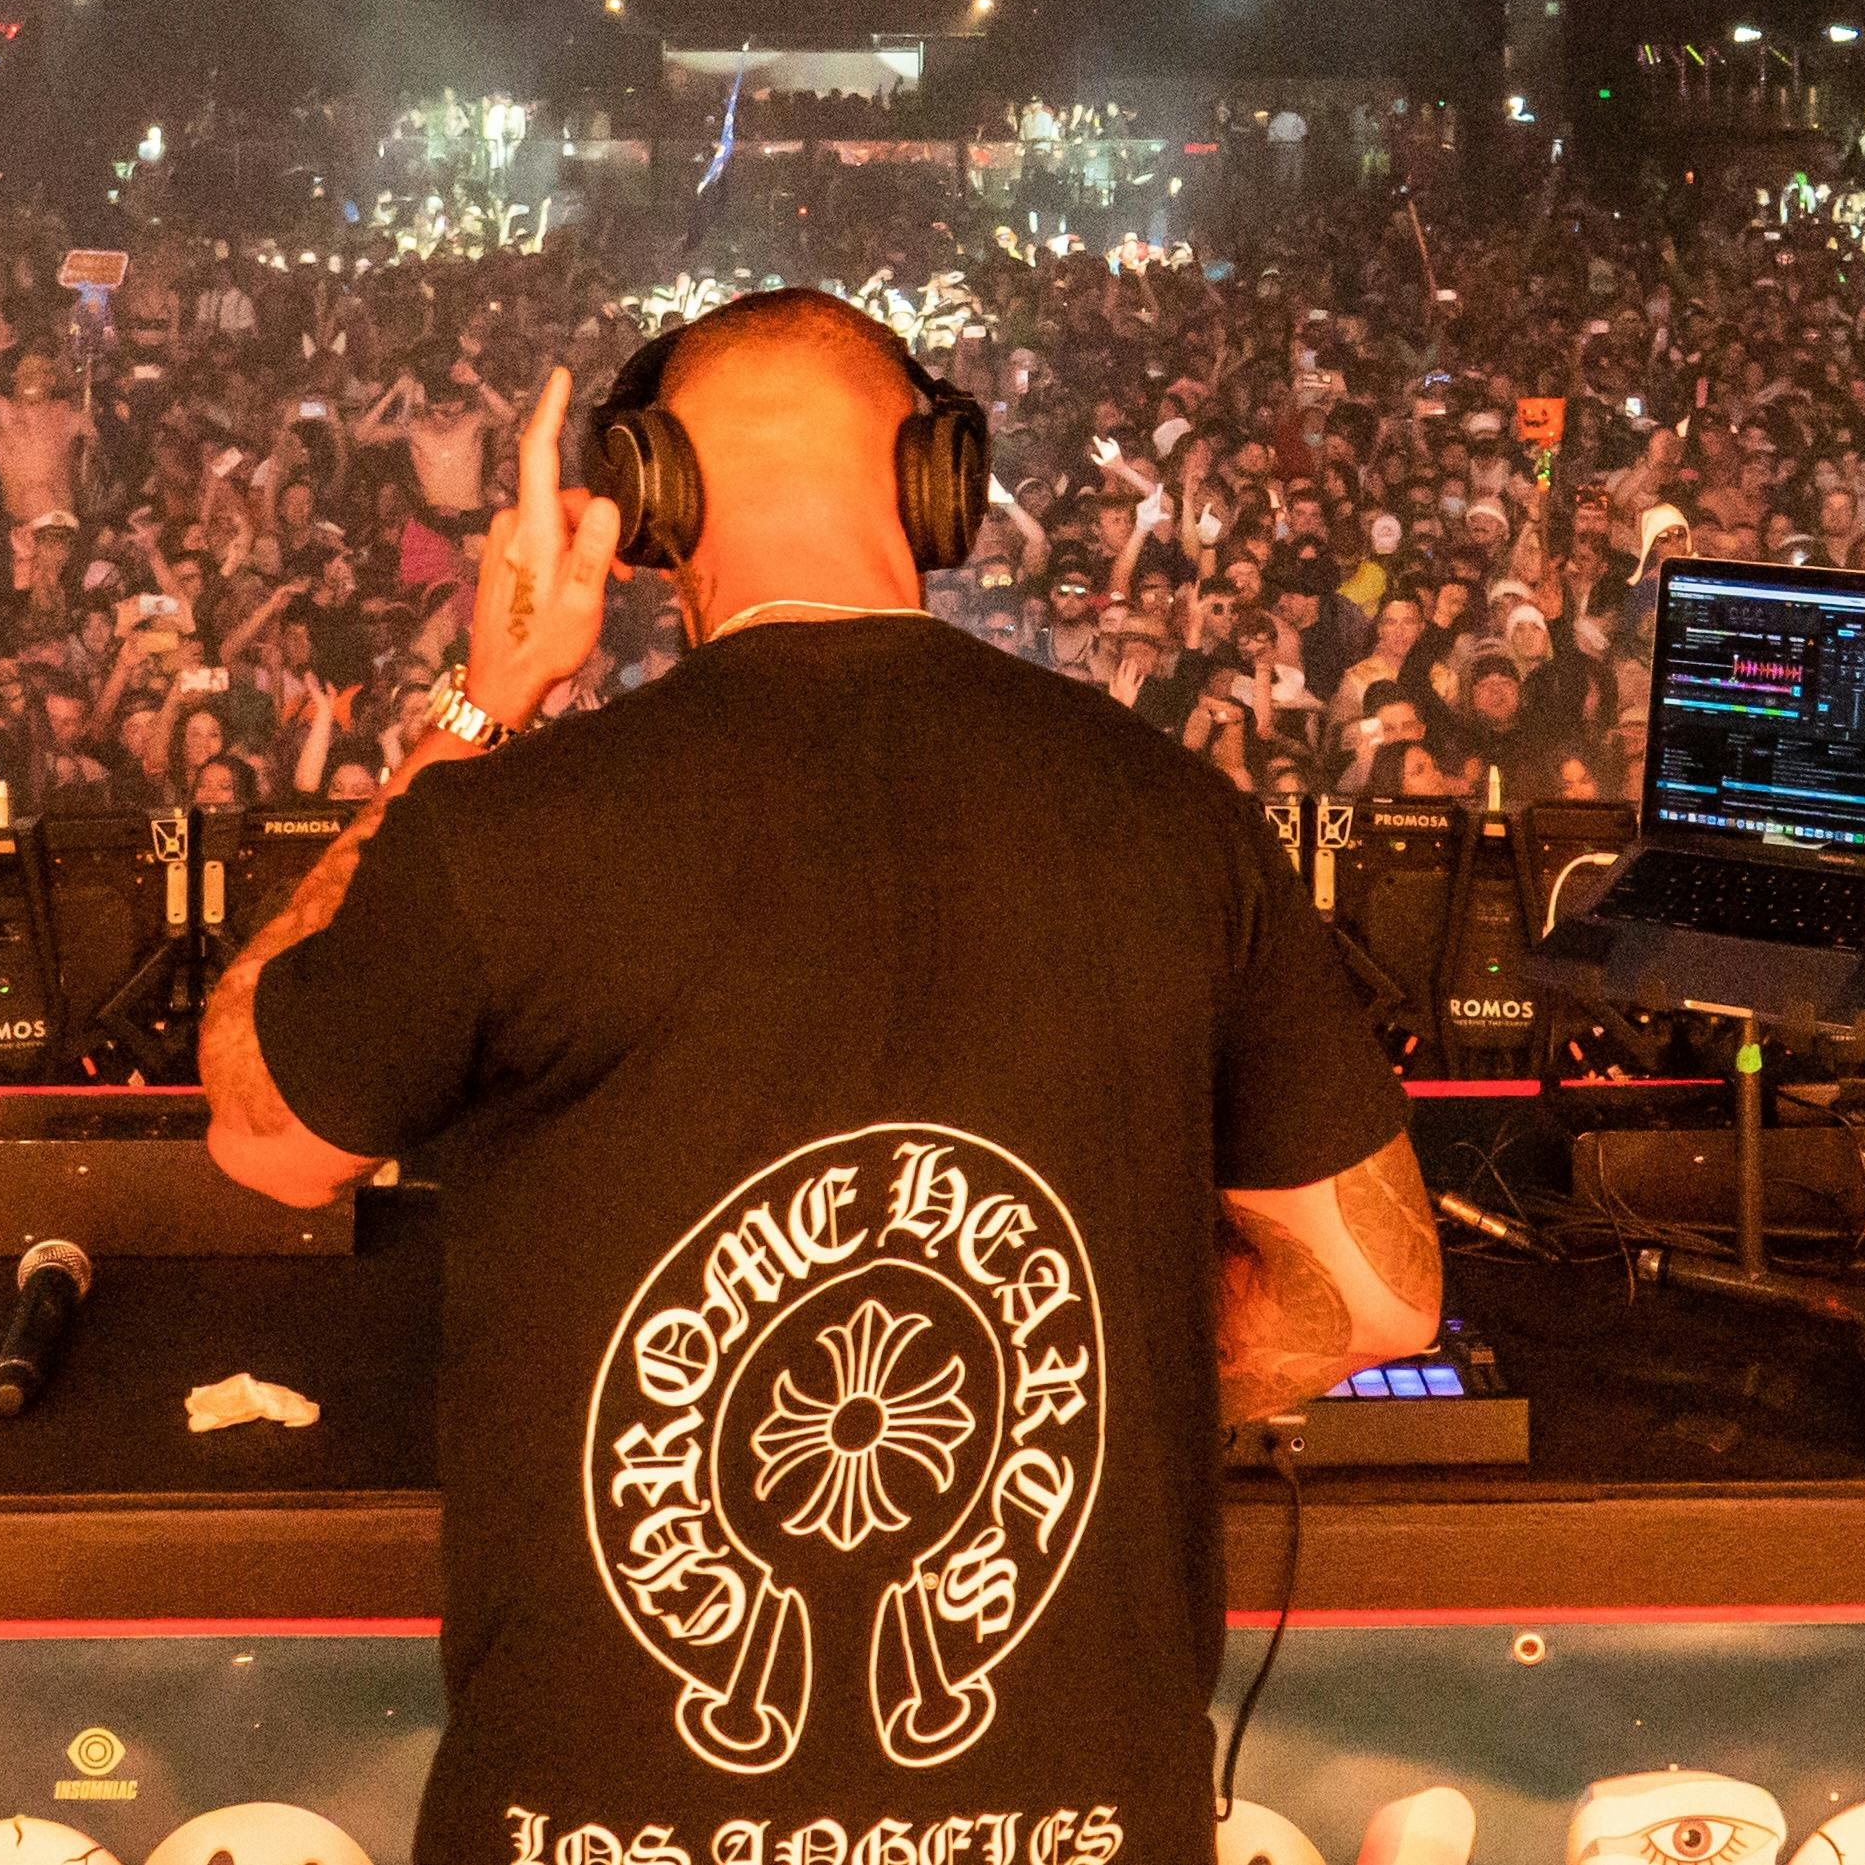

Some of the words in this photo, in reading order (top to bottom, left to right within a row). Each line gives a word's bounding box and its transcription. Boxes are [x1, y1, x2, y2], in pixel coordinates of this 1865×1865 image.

[263, 820, 341, 835] PROMOSA
[1374, 813, 1449, 828] PROMOSA
[610, 1164, 870, 1647] CHROME
[876, 1141, 1090, 1644] HEARTS
[53, 1779, 138, 1801] INSOMNIAC
[505, 1805, 692, 1865] LOS
[710, 1804, 1124, 1865] ANGELES
